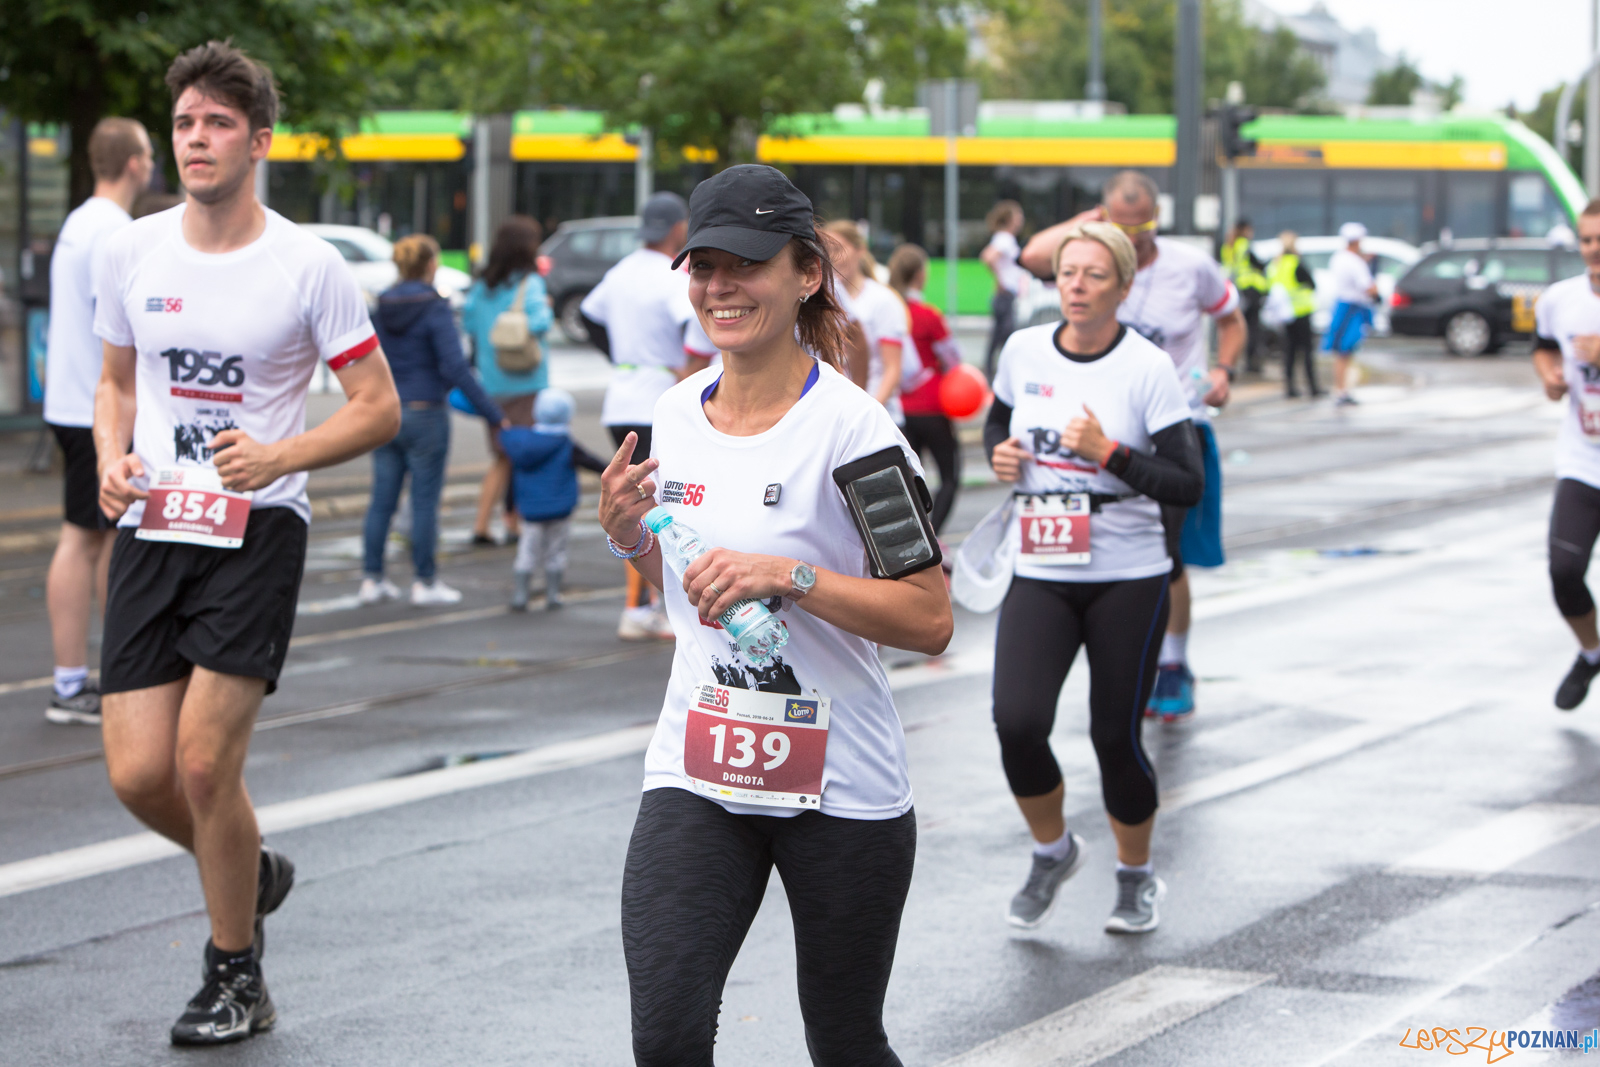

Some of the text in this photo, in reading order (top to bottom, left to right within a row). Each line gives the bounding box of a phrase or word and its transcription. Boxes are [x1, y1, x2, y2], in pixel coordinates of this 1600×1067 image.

[160, 348, 245, 388] 1956
[664, 480, 684, 491] LOTTO
[683, 482, 706, 507] '56
[162, 491, 228, 525] 854
[1028, 517, 1073, 545] 422
[713, 686, 730, 708] '56
[793, 707, 810, 717] LOTTO
[709, 723, 791, 771] 139
[722, 771, 765, 786] DOROTA
